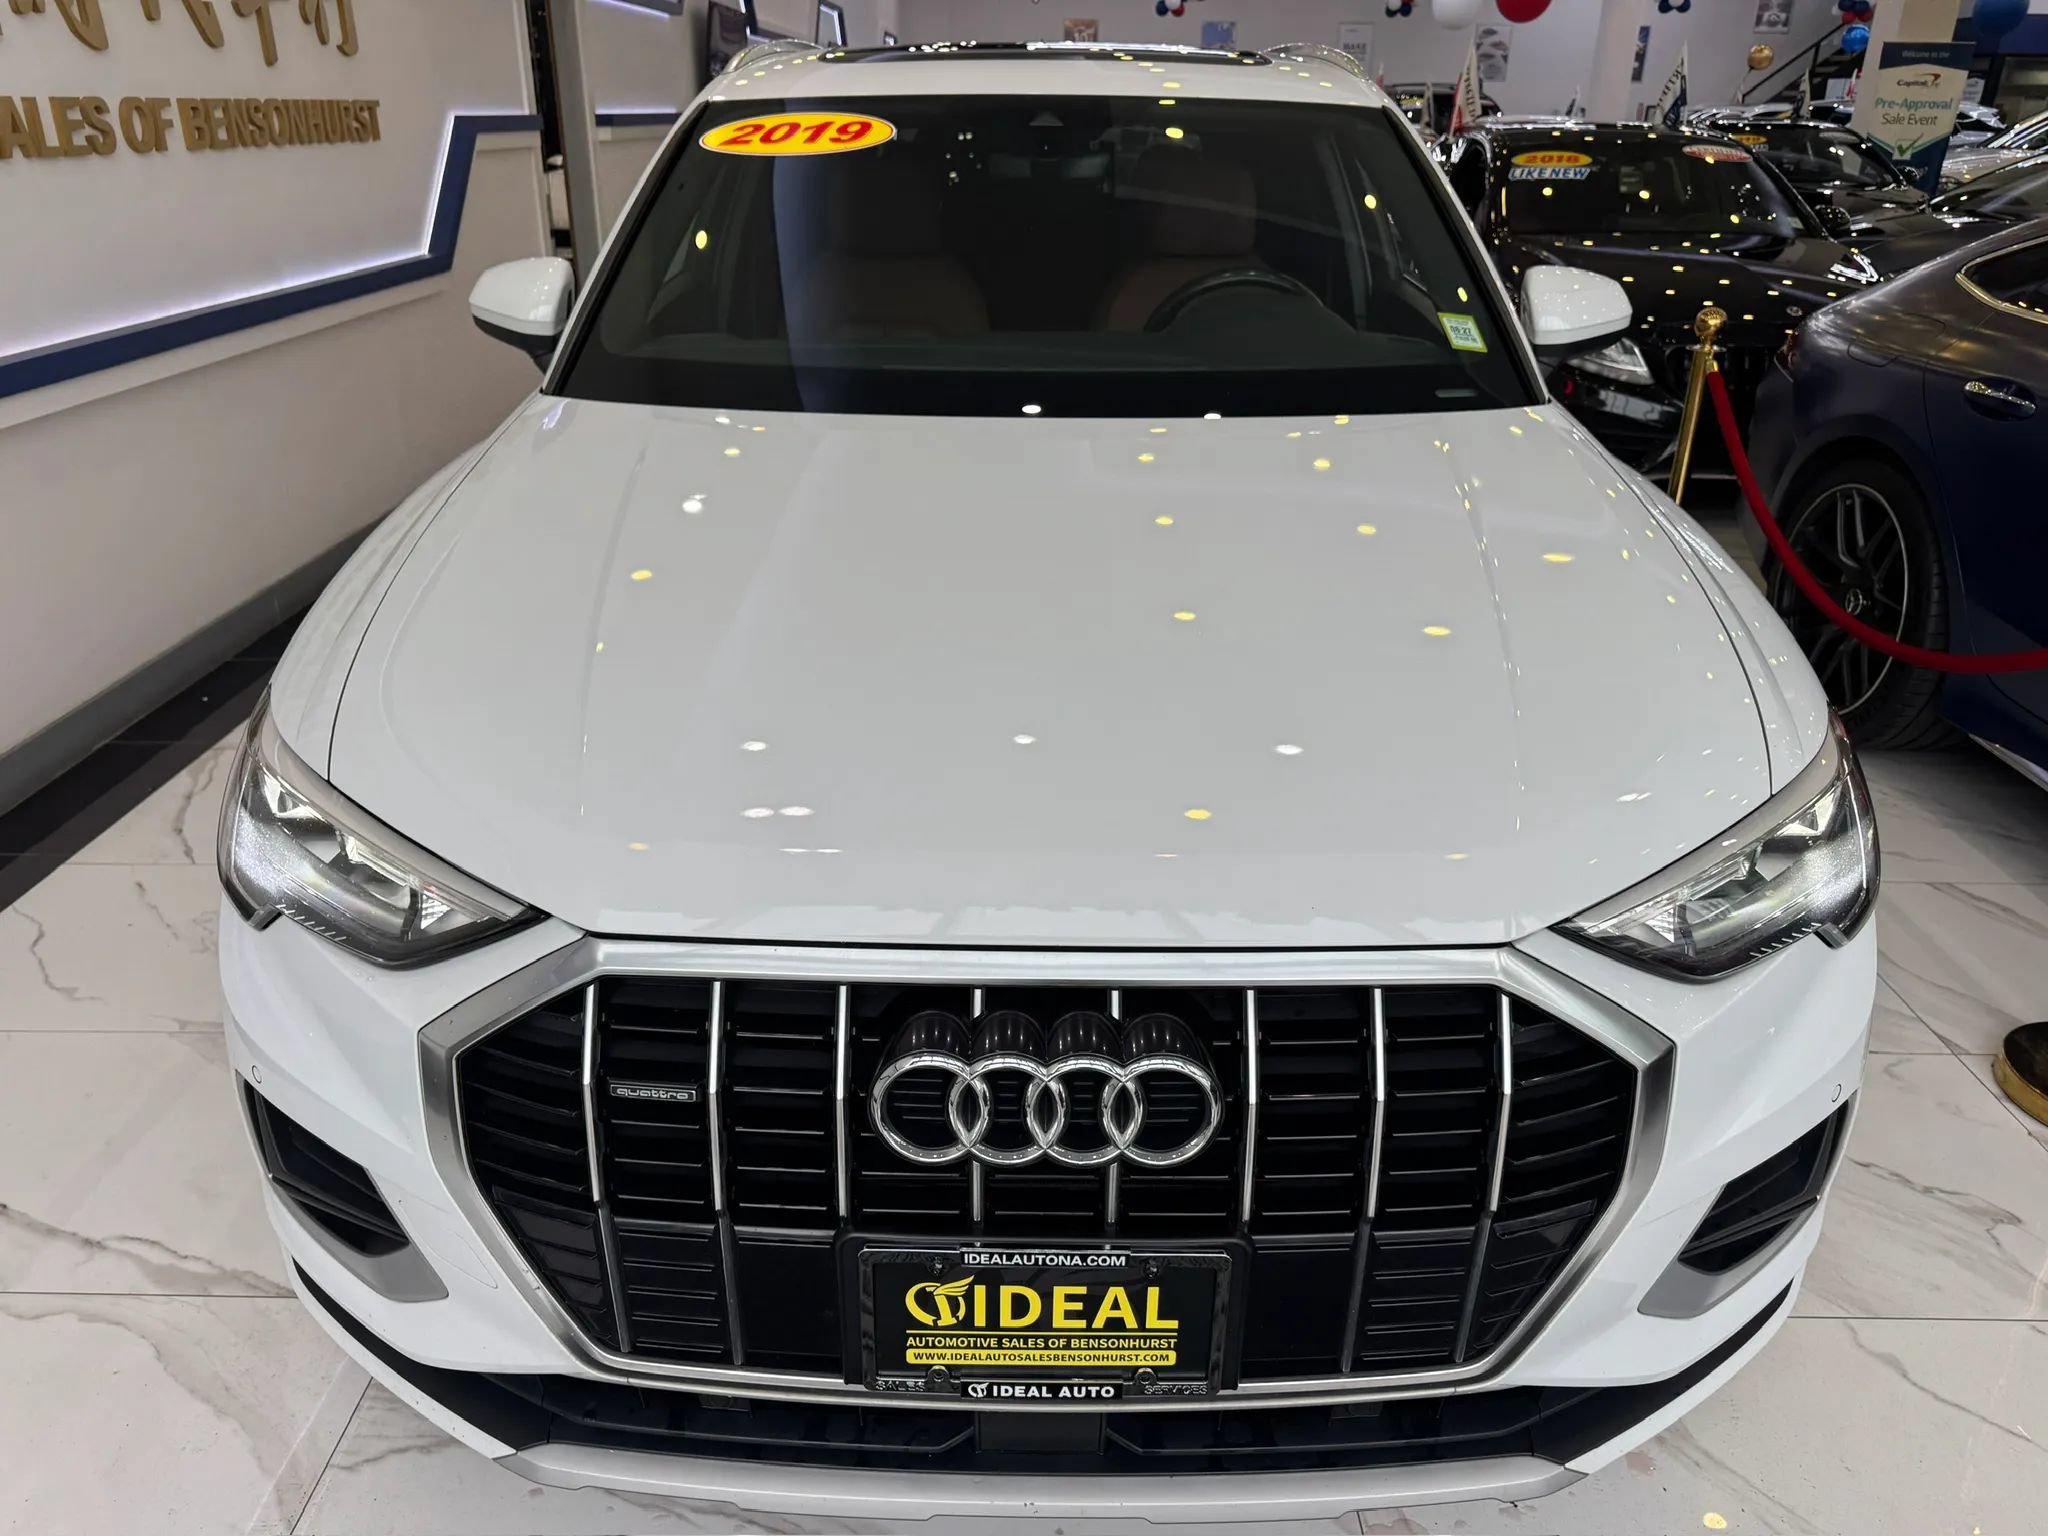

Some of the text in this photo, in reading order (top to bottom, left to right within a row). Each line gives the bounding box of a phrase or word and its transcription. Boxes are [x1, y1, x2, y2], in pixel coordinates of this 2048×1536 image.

[1875, 97, 1952, 112] Pre-Approval
[118, 96, 174, 155] OF
[176, 97, 381, 152] BENSONHURST
[1881, 113, 1938, 126] Sale Event
[717, 120, 873, 147] 2019
[1511, 168, 1588, 179] LIKE NEW
[616, 1088, 688, 1099] quattro
[964, 1253, 1126, 1267] IDEALAUTONA.COM
[973, 1284, 1179, 1330] IDEAL
[906, 1336, 1178, 1349] AUTOMOTIVE SALES OF BENSONHURST
[913, 1352, 1169, 1363] WWW.IDEALAUTOSALESBENSONHURST.COM
[875, 1380, 926, 1392] SALES
[992, 1385, 1115, 1398] IDEAL AUTO
